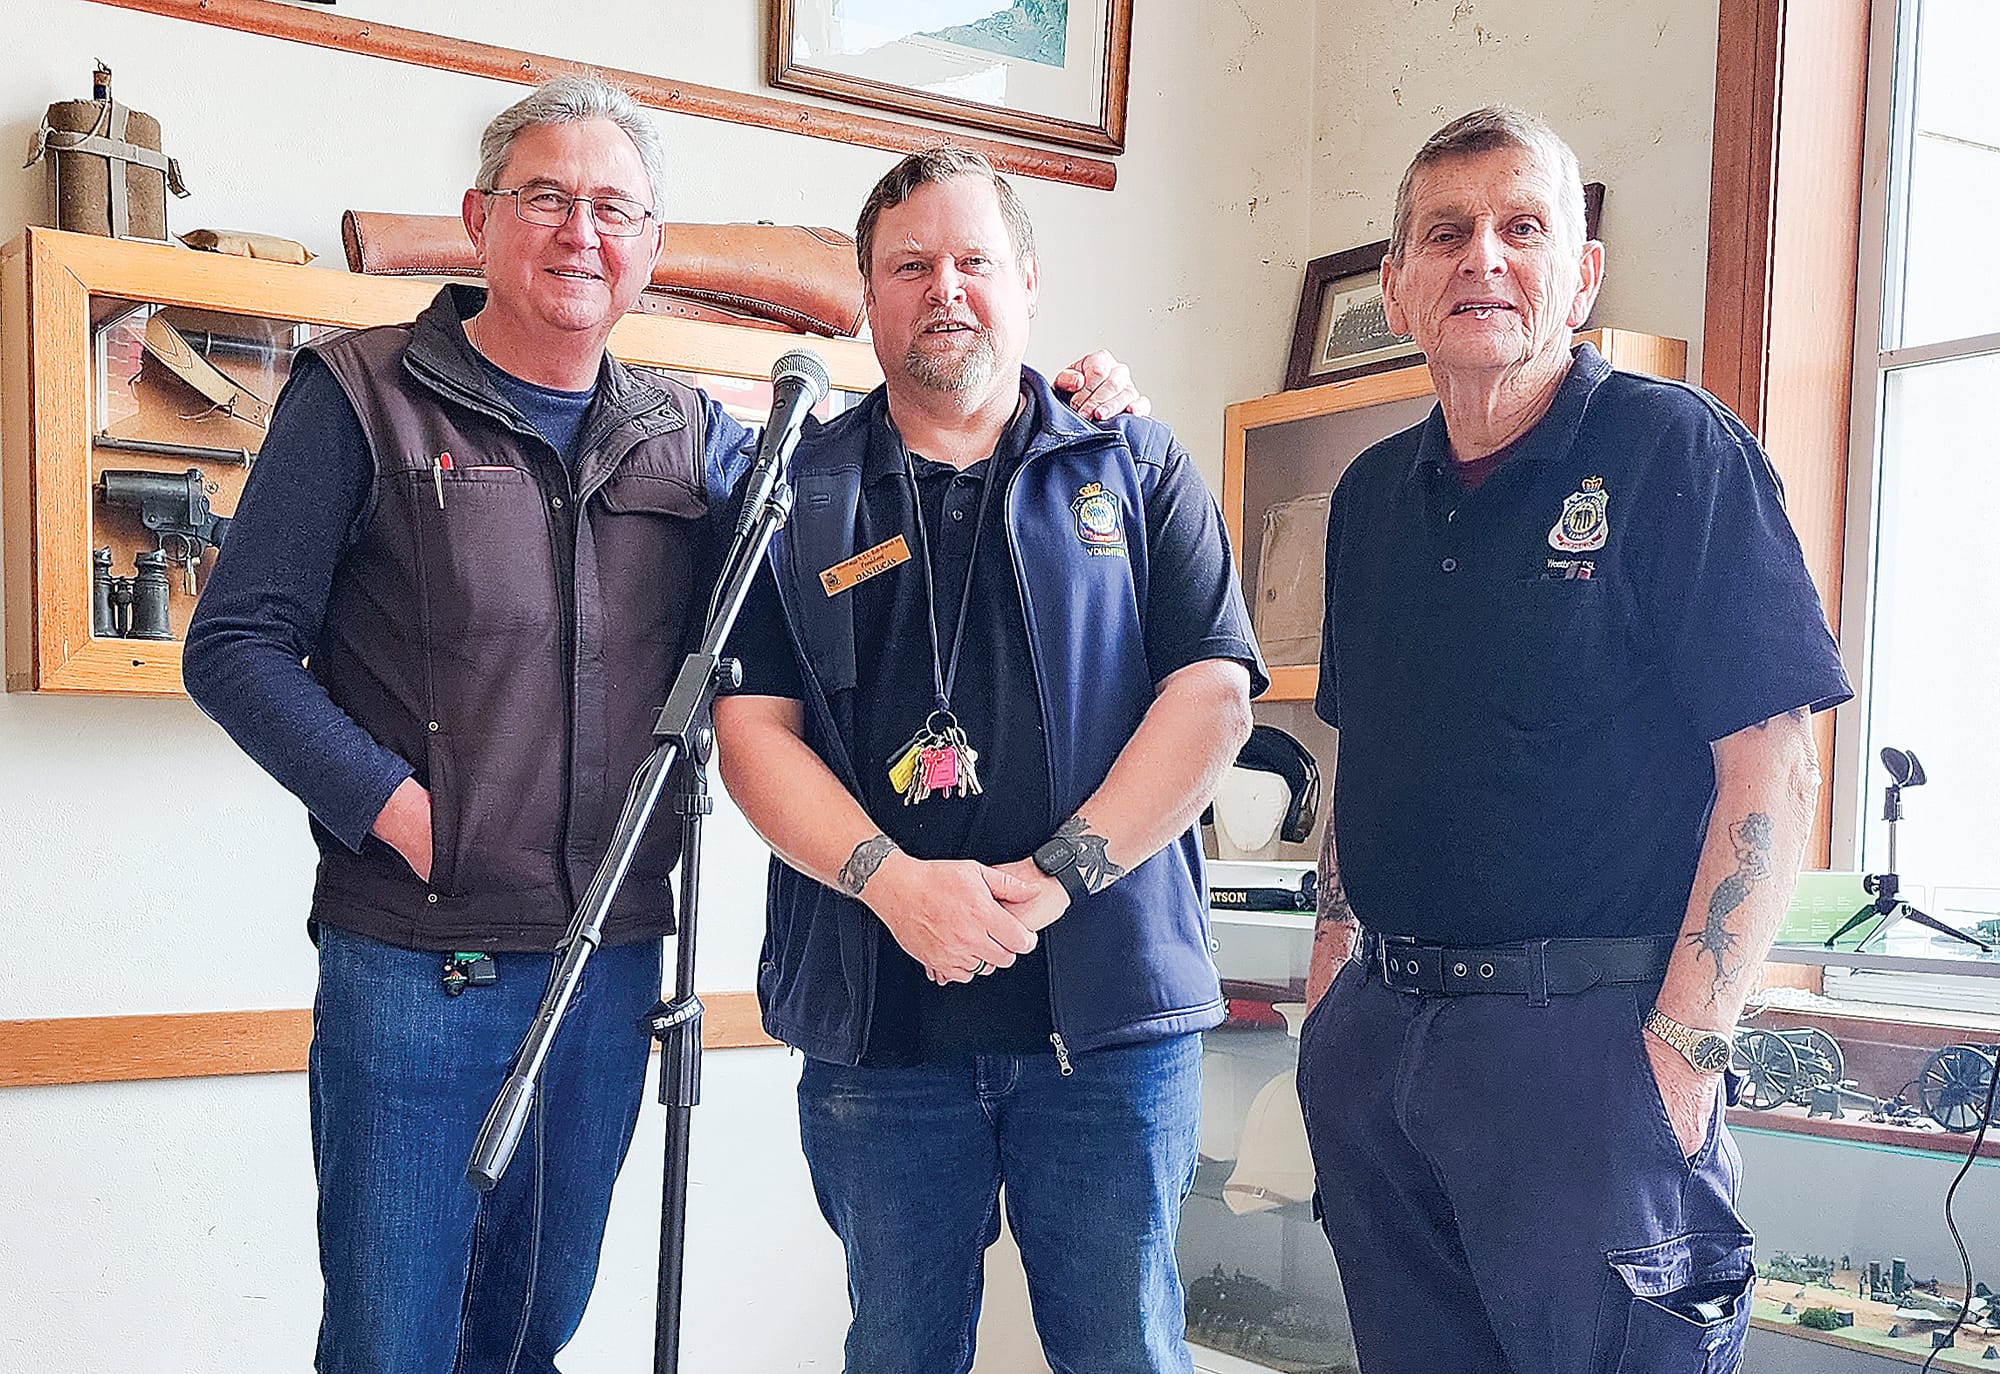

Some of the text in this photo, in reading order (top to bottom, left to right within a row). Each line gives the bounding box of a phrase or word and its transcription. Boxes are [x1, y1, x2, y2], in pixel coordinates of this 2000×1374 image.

[855, 568, 873, 581] DAN
[872, 557, 897, 574] LUCAS
[651, 999, 701, 1030] SHURE
